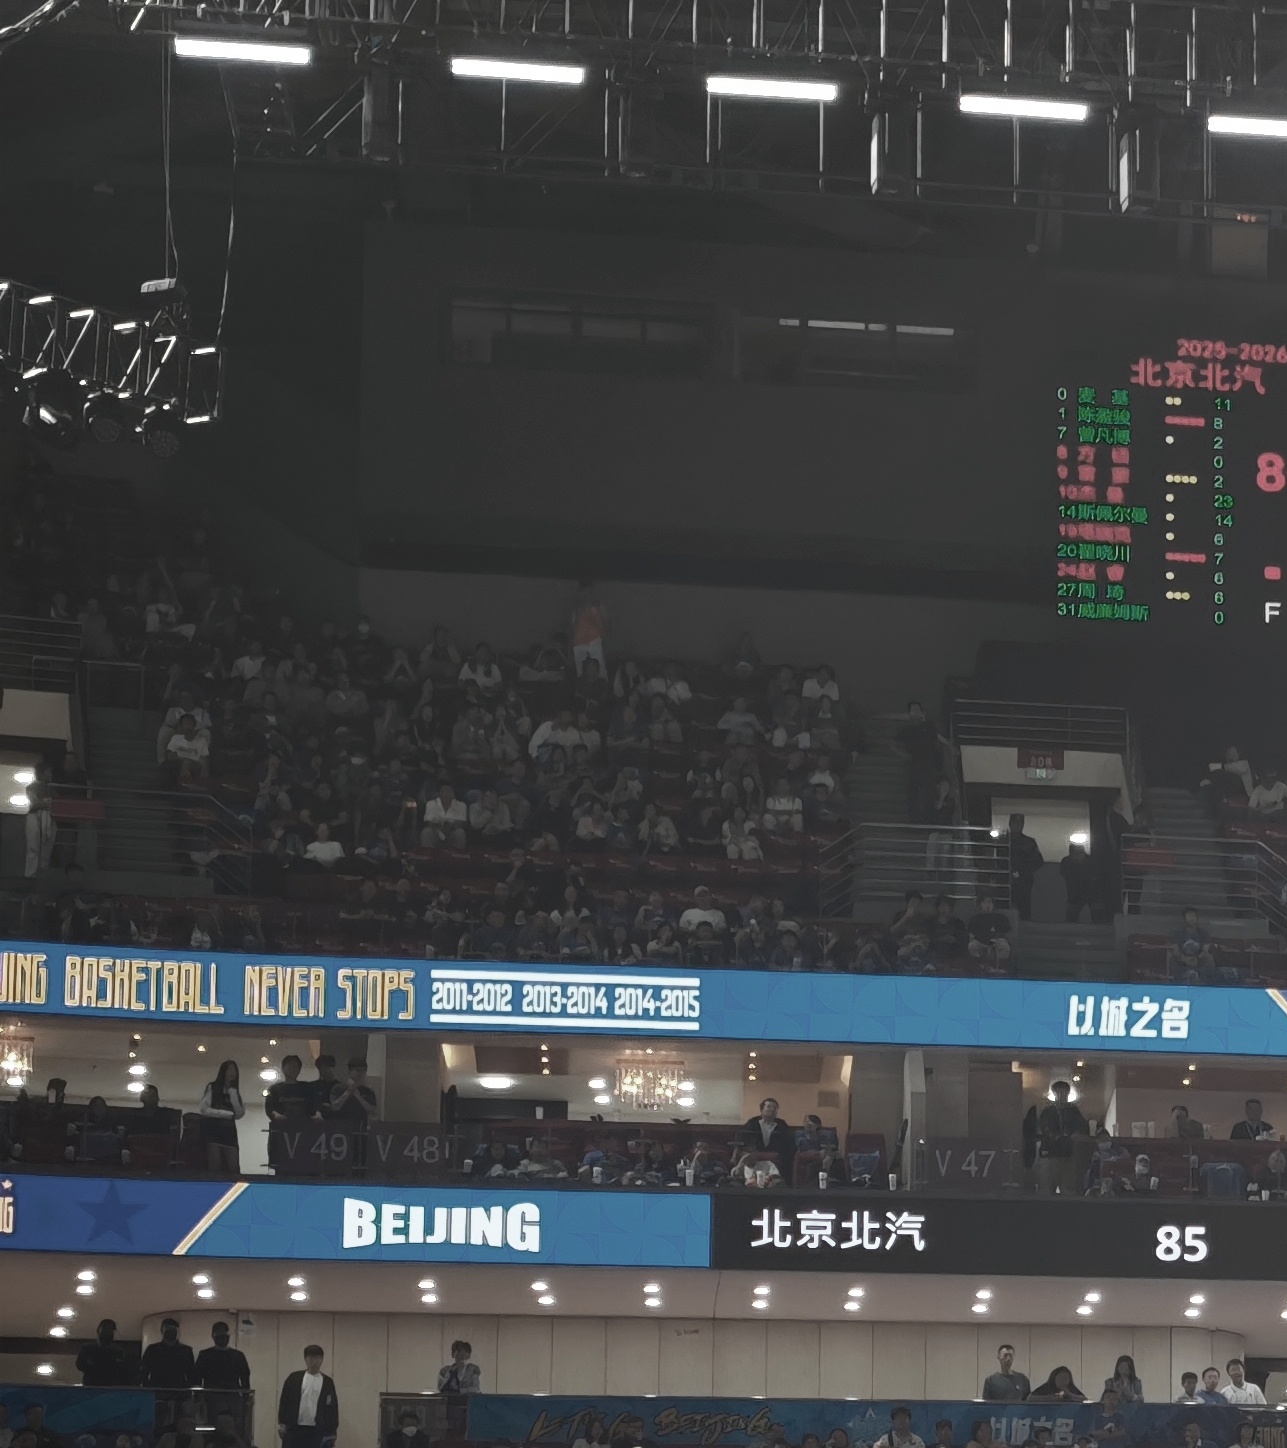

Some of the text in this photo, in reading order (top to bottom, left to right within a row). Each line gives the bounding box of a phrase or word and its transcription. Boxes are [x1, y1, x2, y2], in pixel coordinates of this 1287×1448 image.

[1130, 358, 1266, 395] 北京北汽
[1057, 387, 1067, 401] 0
[1058, 407, 1066, 420] 1
[1057, 426, 1067, 440] 7
[1214, 437, 1223, 449] 2
[1214, 456, 1223, 469] 0
[1214, 476, 1223, 488] 2
[1059, 505, 1076, 518] 14
[1216, 515, 1233, 528] 14
[1057, 544, 1077, 557] 20
[1215, 553, 1224, 565] 7
[1057, 583, 1077, 597] 27
[1058, 603, 1076, 616] 31
[1214, 611, 1224, 624] 0
[1264, 602, 1282, 624] F
[65, 954, 226, 1016] BASKETBALL
[244, 964, 326, 1017] NEVER
[337, 968, 415, 1020] STOPS
[431, 981, 701, 1018] 2011-2012 2013-2014 2014-2015
[1067, 995, 1191, 1041] 以城之名
[283, 1131, 349, 1163] V 49
[377, 1134, 441, 1166] V 48
[935, 1149, 996, 1180] V 47
[343, 1197, 541, 1253] BEIJING
[751, 1208, 926, 1252] 北京北汽
[1156, 1225, 1209, 1263] 85
